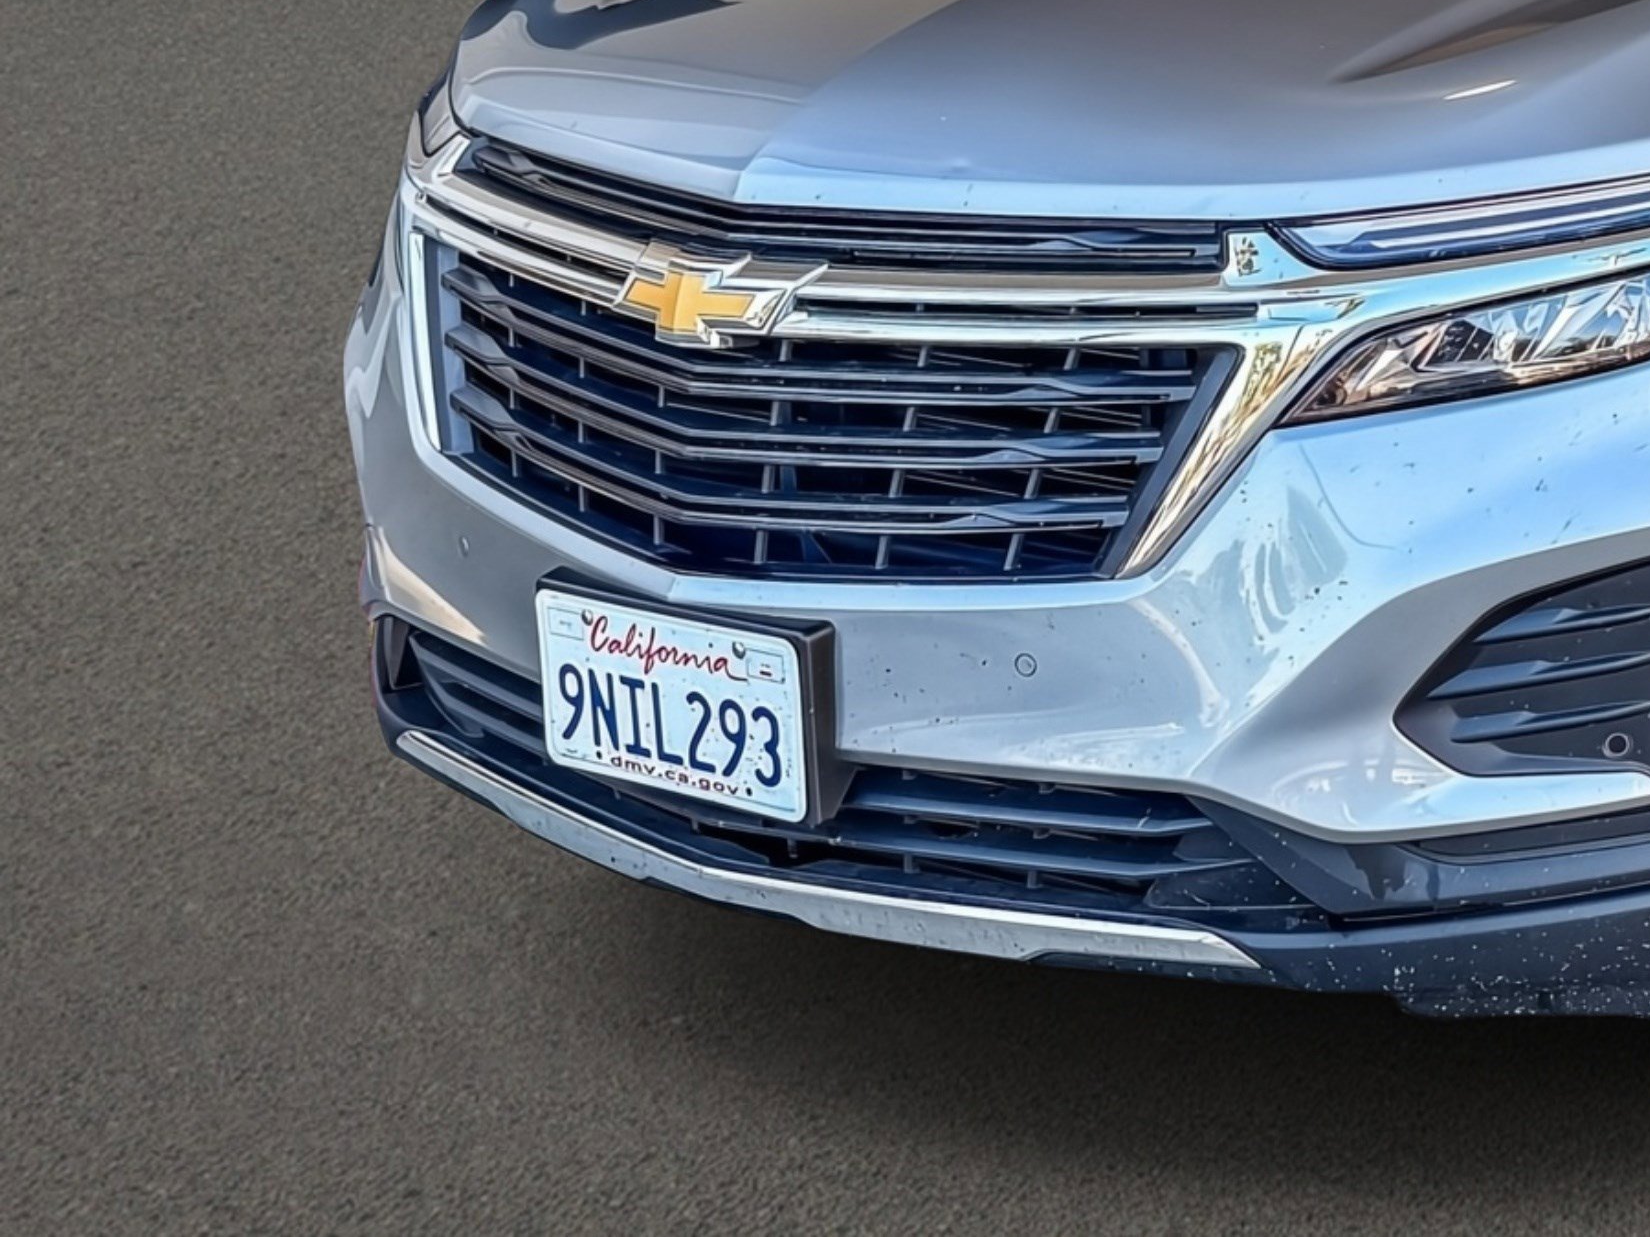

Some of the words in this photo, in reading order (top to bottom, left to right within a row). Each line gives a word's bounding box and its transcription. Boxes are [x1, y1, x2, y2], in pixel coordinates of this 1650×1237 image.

[589, 615, 748, 681] California
[558, 663, 783, 788] 9NIL293
[610, 754, 740, 796] dmv.ca.gov
